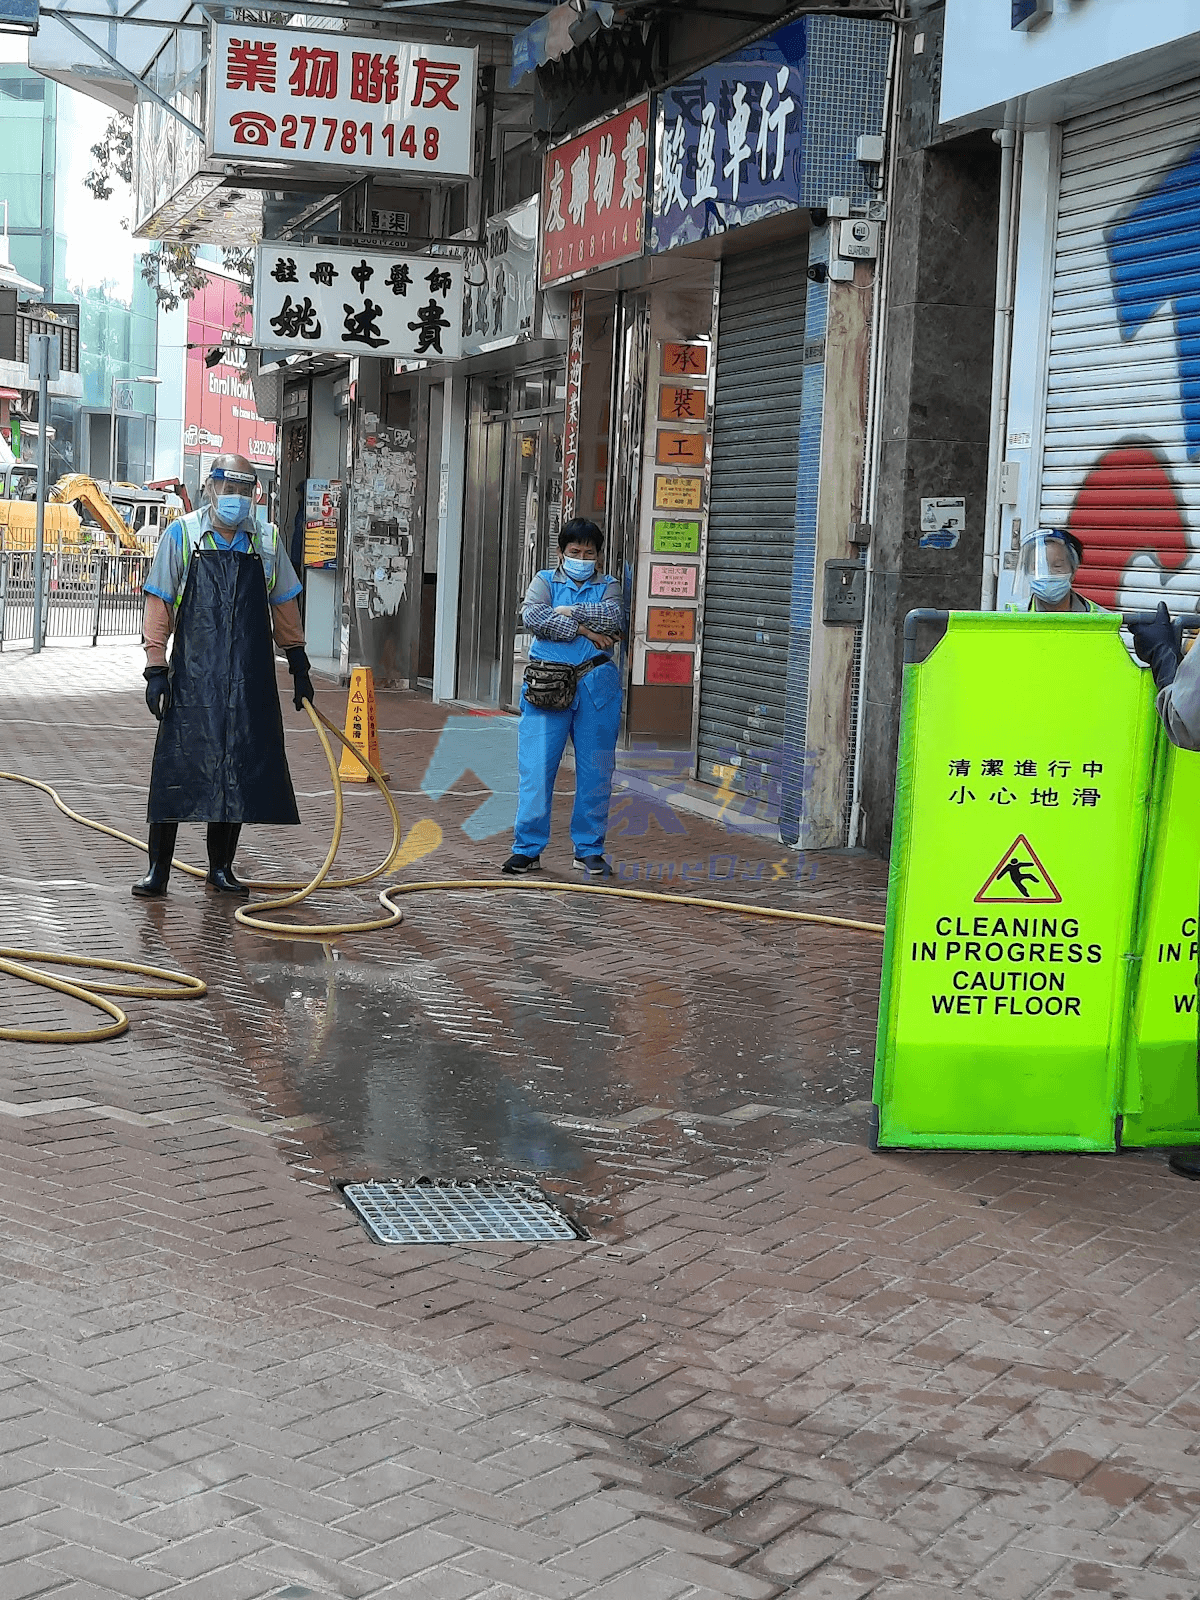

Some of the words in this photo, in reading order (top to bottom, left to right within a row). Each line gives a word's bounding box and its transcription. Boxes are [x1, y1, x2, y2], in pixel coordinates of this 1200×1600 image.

[280, 114, 440, 161] 27781148
[270, 257, 453, 299] 註冊中醫師
[270, 295, 451, 355] 姚述貴
[209, 372, 229, 396] Enrol
[948, 759, 1103, 778] 清潔進行中
[948, 786, 1101, 807] 小心地滑
[936, 917, 1079, 938] CLEANING
[911, 942, 937, 961] IN
[946, 942, 1102, 963] PROGRESS
[1158, 943, 1182, 962] IN
[953, 971, 1065, 991] CAUTION
[932, 995, 988, 1014] WET
[994, 996, 1081, 1016] FLOOR
